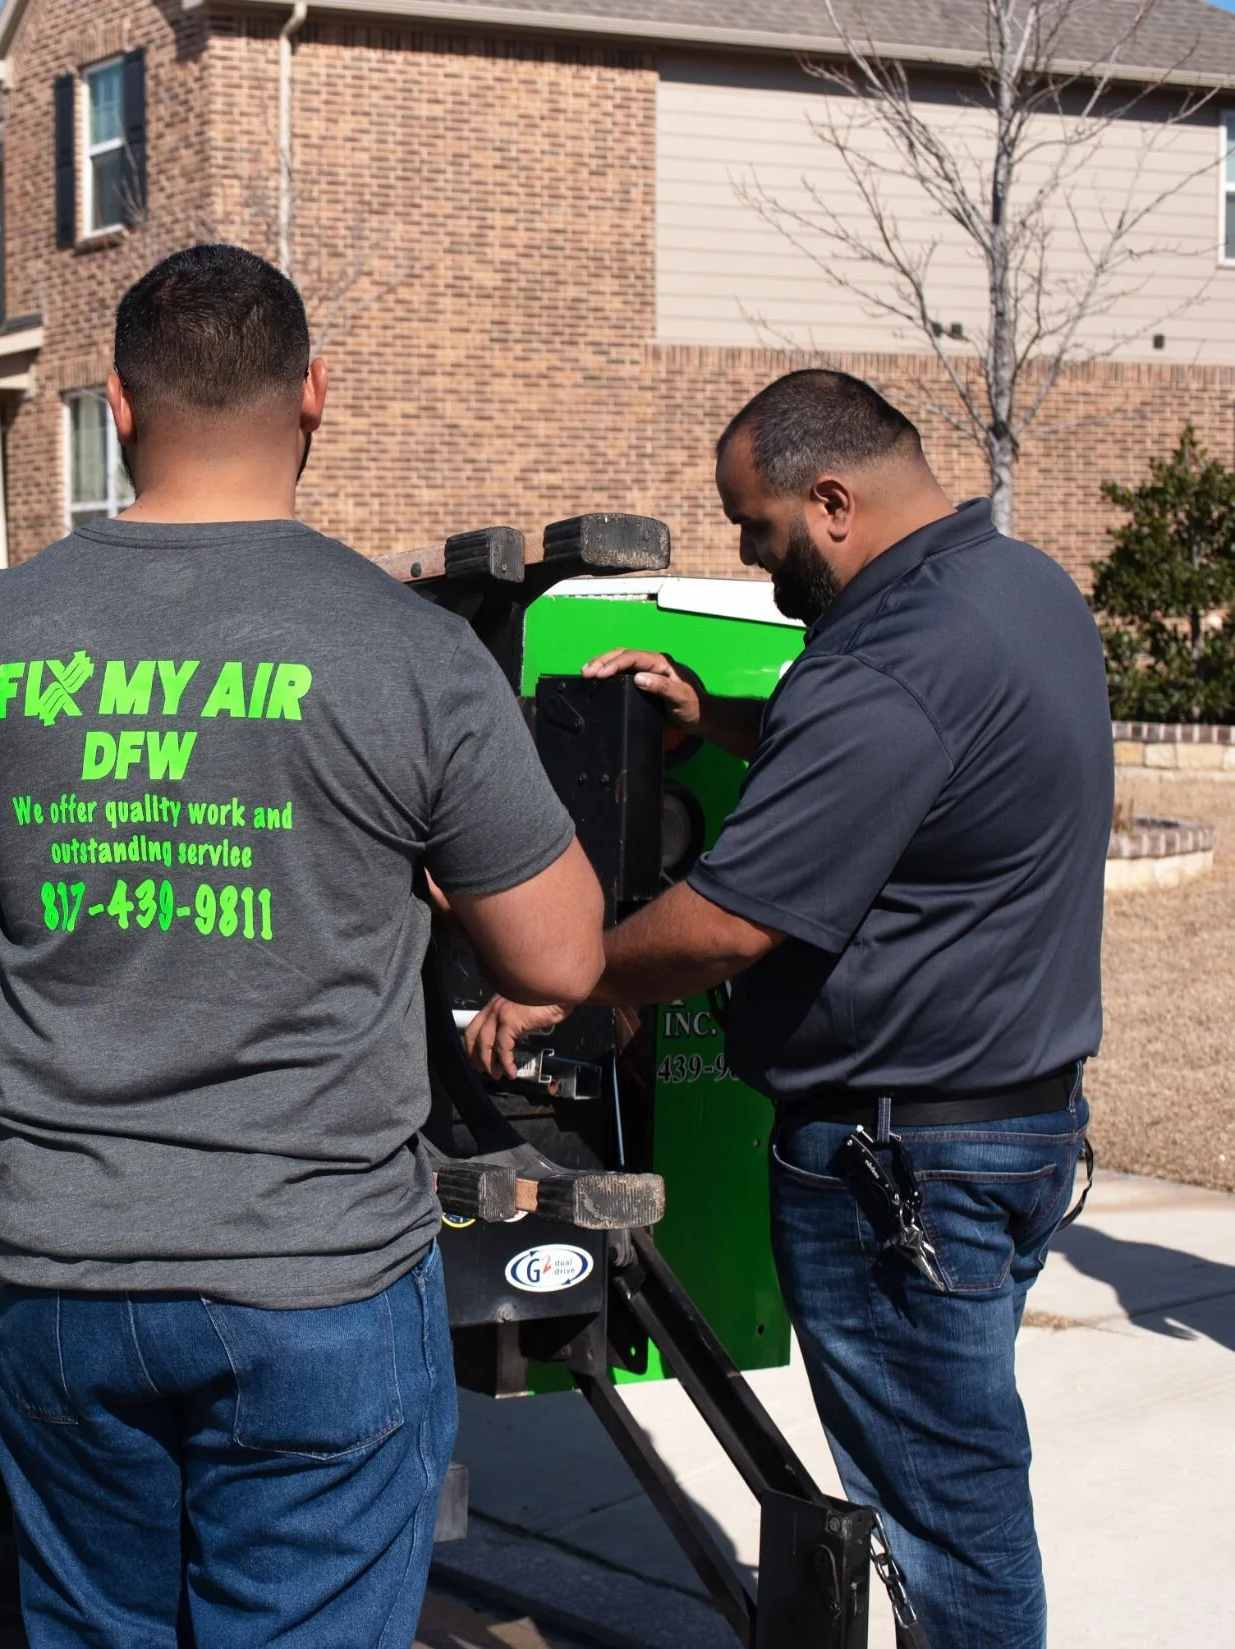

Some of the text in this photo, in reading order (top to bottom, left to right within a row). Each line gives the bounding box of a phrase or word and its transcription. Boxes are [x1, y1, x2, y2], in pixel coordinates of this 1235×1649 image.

[99, 660, 201, 716] MY
[200, 661, 313, 721] AIR
[81, 731, 198, 780] DFW
[13, 793, 293, 829] We offer quality work and
[51, 835, 252, 868] outstanding service
[40, 879, 274, 940] 817-439-9811
[664, 1010, 718, 1037] INC.
[656, 1051, 741, 1084] 439-9
[554, 1258, 573, 1267] dual
[554, 1267, 576, 1276] drive
